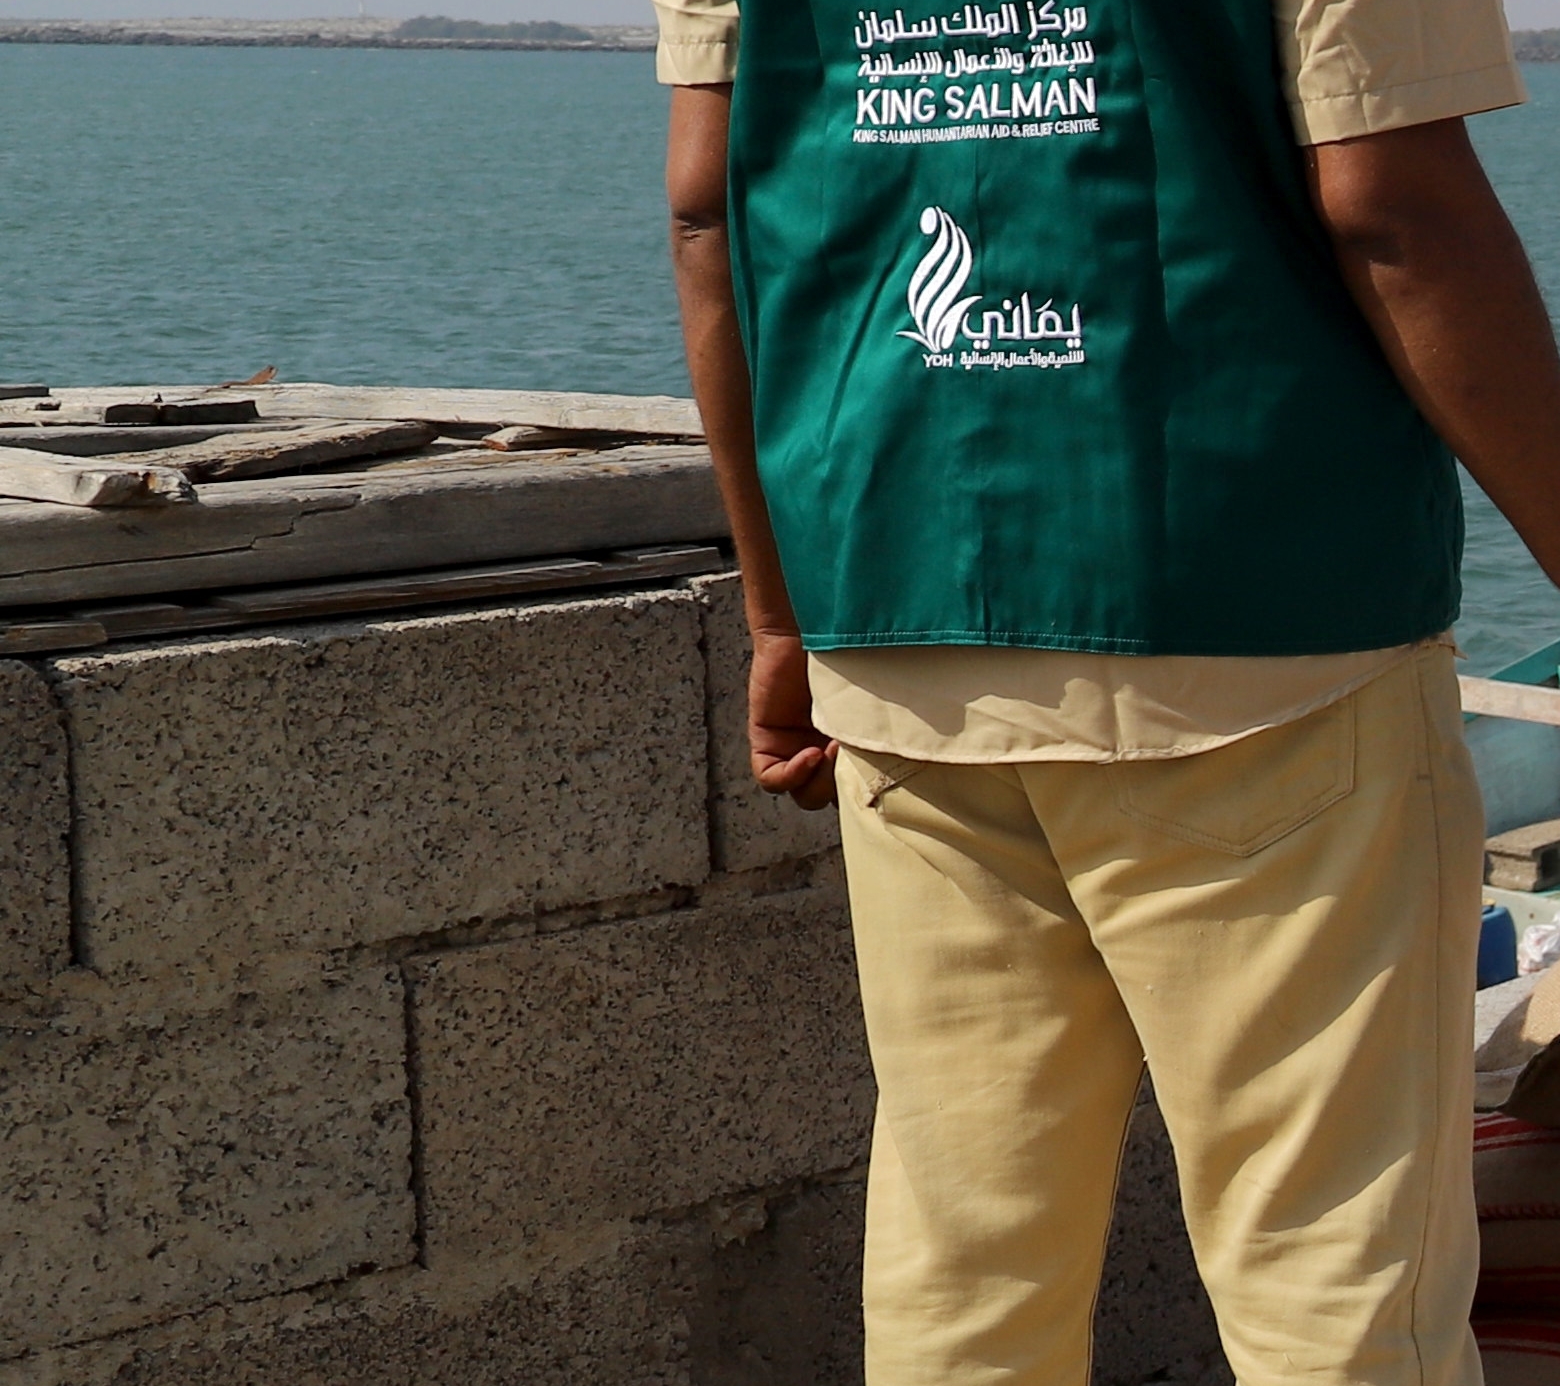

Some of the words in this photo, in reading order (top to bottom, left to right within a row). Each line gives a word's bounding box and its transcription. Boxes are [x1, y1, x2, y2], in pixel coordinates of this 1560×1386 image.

[853, 8, 939, 49] سلمان
[940, 2, 1022, 38] الملك
[857, 50, 943, 84] الإنسانية
[1029, 37, 1095, 73] للإغاثة
[855, 86, 937, 126] KING
[943, 76, 1098, 121] SALMAN
[853, 128, 880, 144] KING
[879, 127, 922, 145] SALMAN
[921, 123, 990, 144] HUMANITARIAN
[990, 123, 1010, 139] AID
[1010, 123, 1023, 138] &
[1021, 121, 1055, 138] RELIEF
[1053, 117, 1101, 136] CENTRE
[922, 352, 954, 369] YDH
